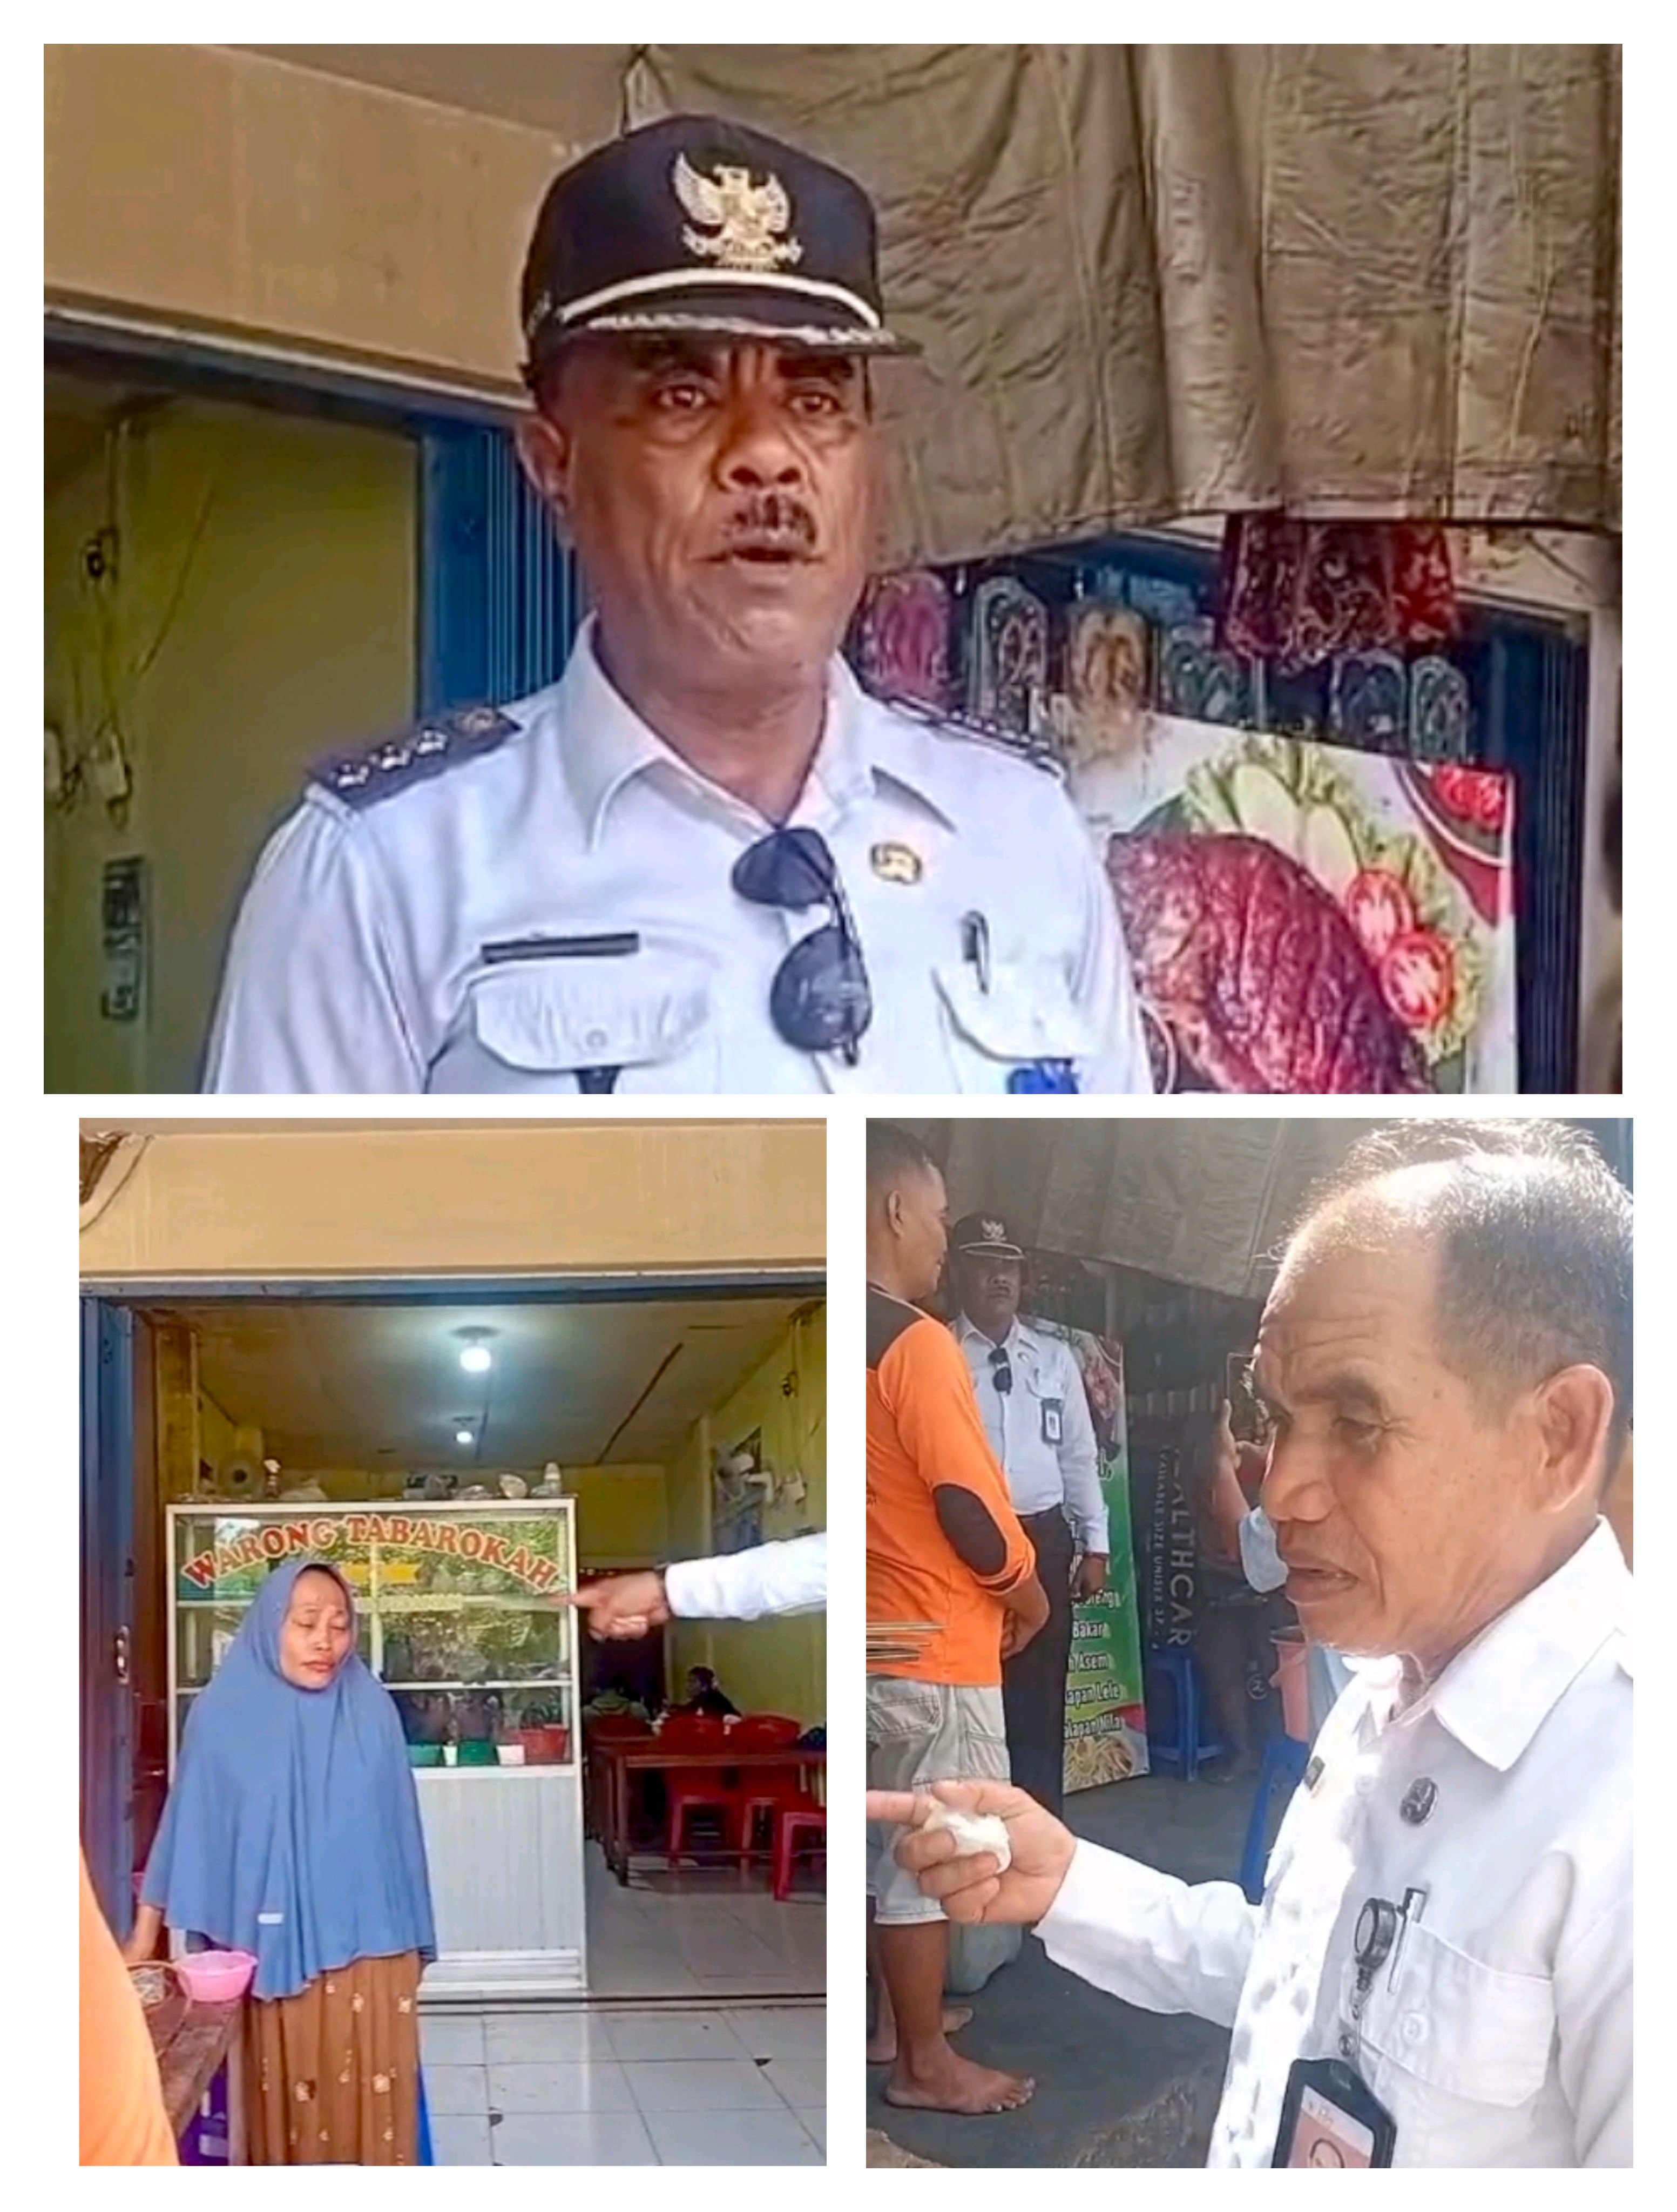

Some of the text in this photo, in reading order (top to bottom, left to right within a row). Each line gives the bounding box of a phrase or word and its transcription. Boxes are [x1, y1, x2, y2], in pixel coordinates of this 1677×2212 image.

[1153, 1520, 1165, 1550] SIZE
[182, 1514, 559, 1590] WARONG TABAROKAH
[1095, 1680, 1120, 1702] Lele
[1098, 1713, 1122, 1732] Nila
